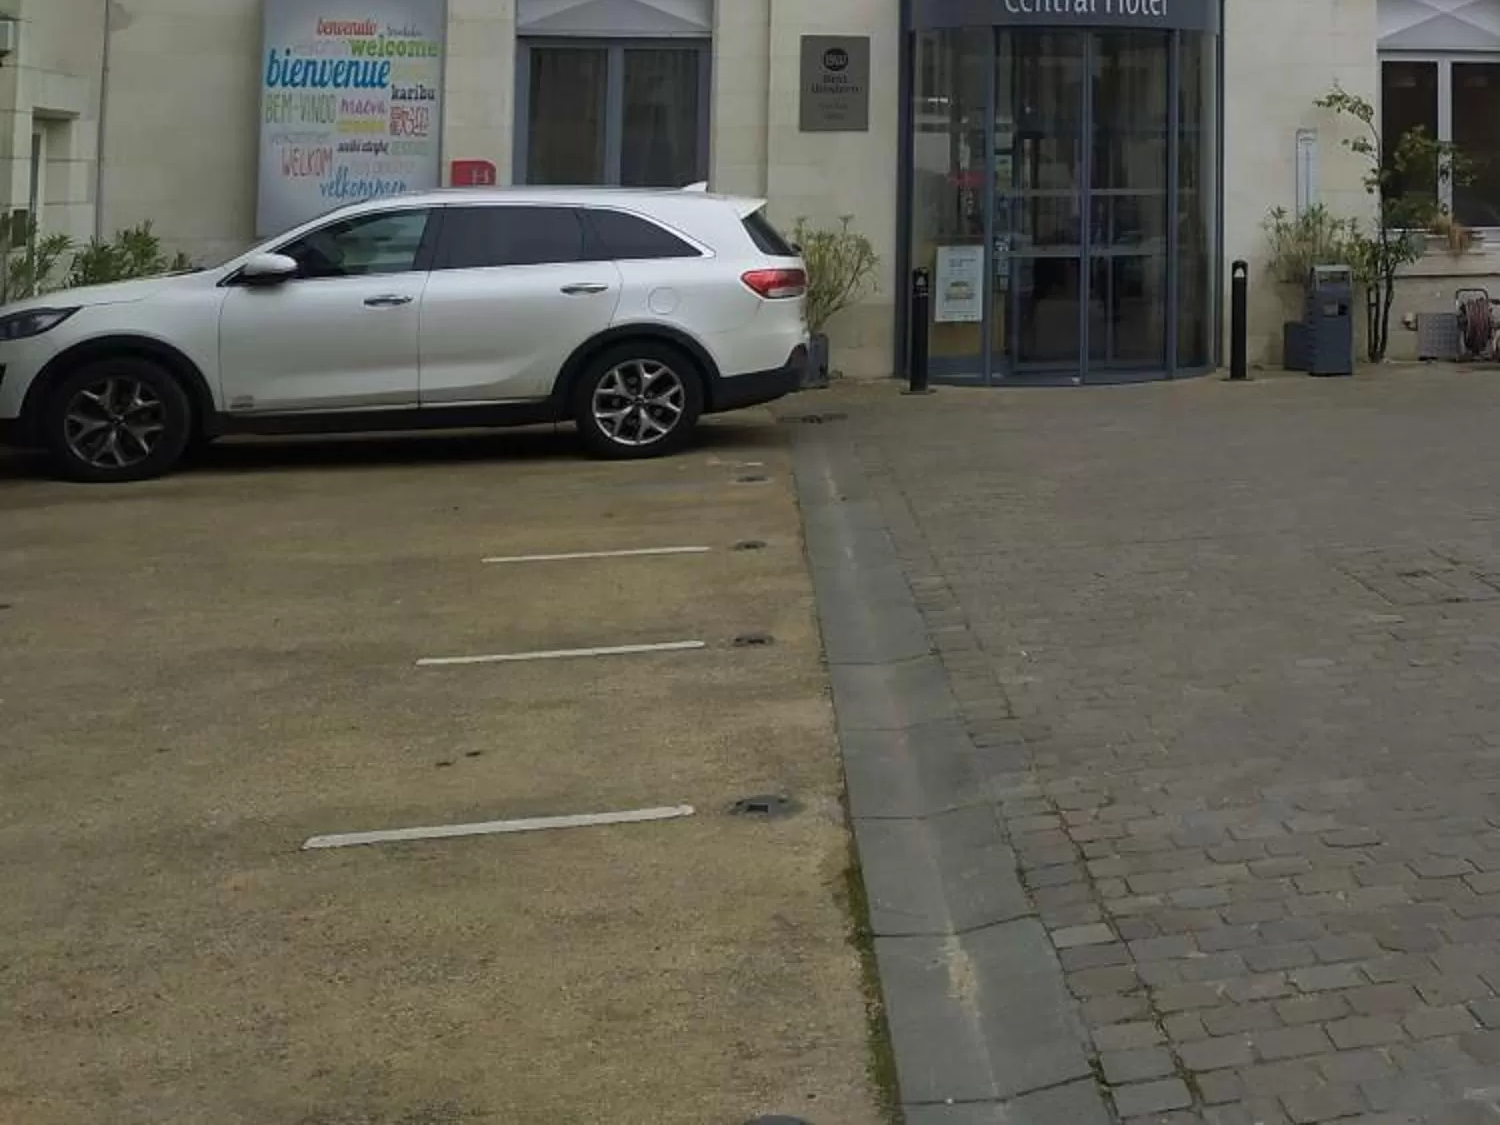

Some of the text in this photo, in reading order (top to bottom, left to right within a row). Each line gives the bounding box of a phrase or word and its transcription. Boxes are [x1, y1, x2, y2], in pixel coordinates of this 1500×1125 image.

[349, 34, 440, 58] welcome
[265, 48, 391, 89] bienvenue
[391, 85, 436, 101] karibu
[281, 145, 333, 176] WELKOM
